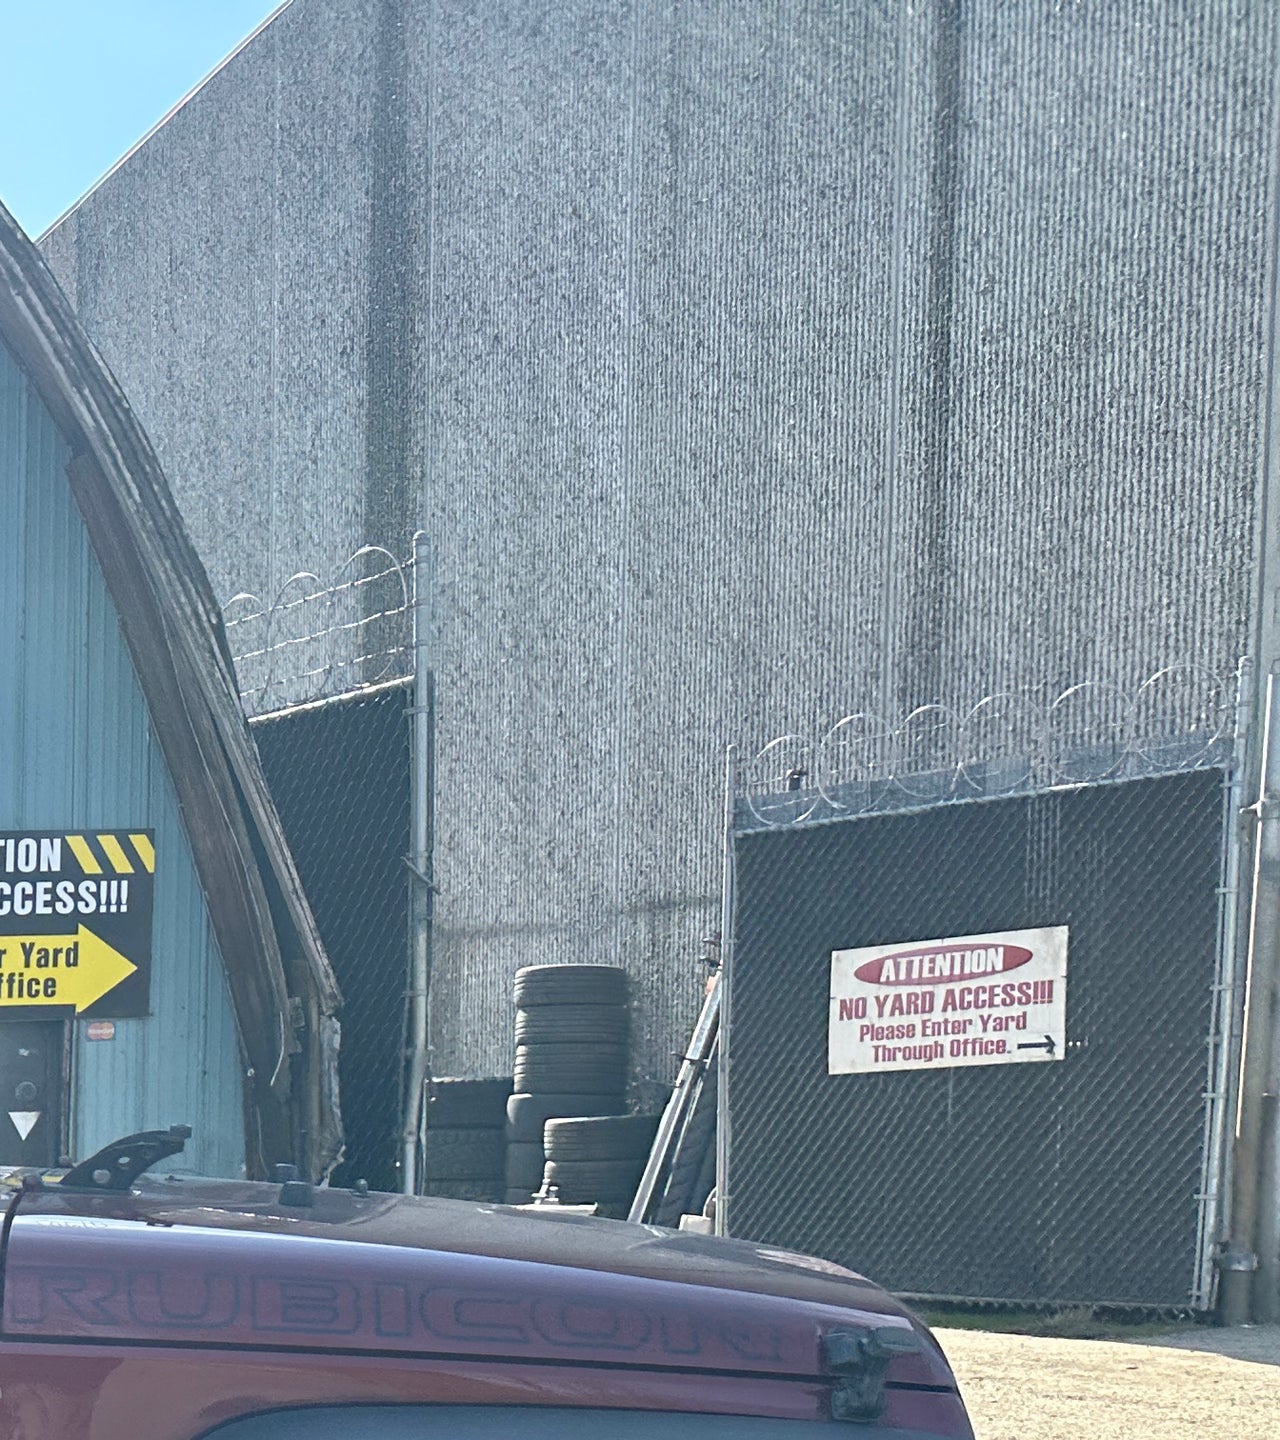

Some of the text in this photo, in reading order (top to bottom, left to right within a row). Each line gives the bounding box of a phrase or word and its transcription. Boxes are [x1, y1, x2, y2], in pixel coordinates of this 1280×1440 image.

[20, 940, 80, 969] Yard
[879, 946, 1005, 983] ATTENTION
[839, 980, 1055, 1021] NO YARD ACCESS!!!
[859, 1011, 1028, 1043] Please Enter Yard
[872, 1042, 944, 1064] Through
[8, 1264, 805, 1366] RUBICON
